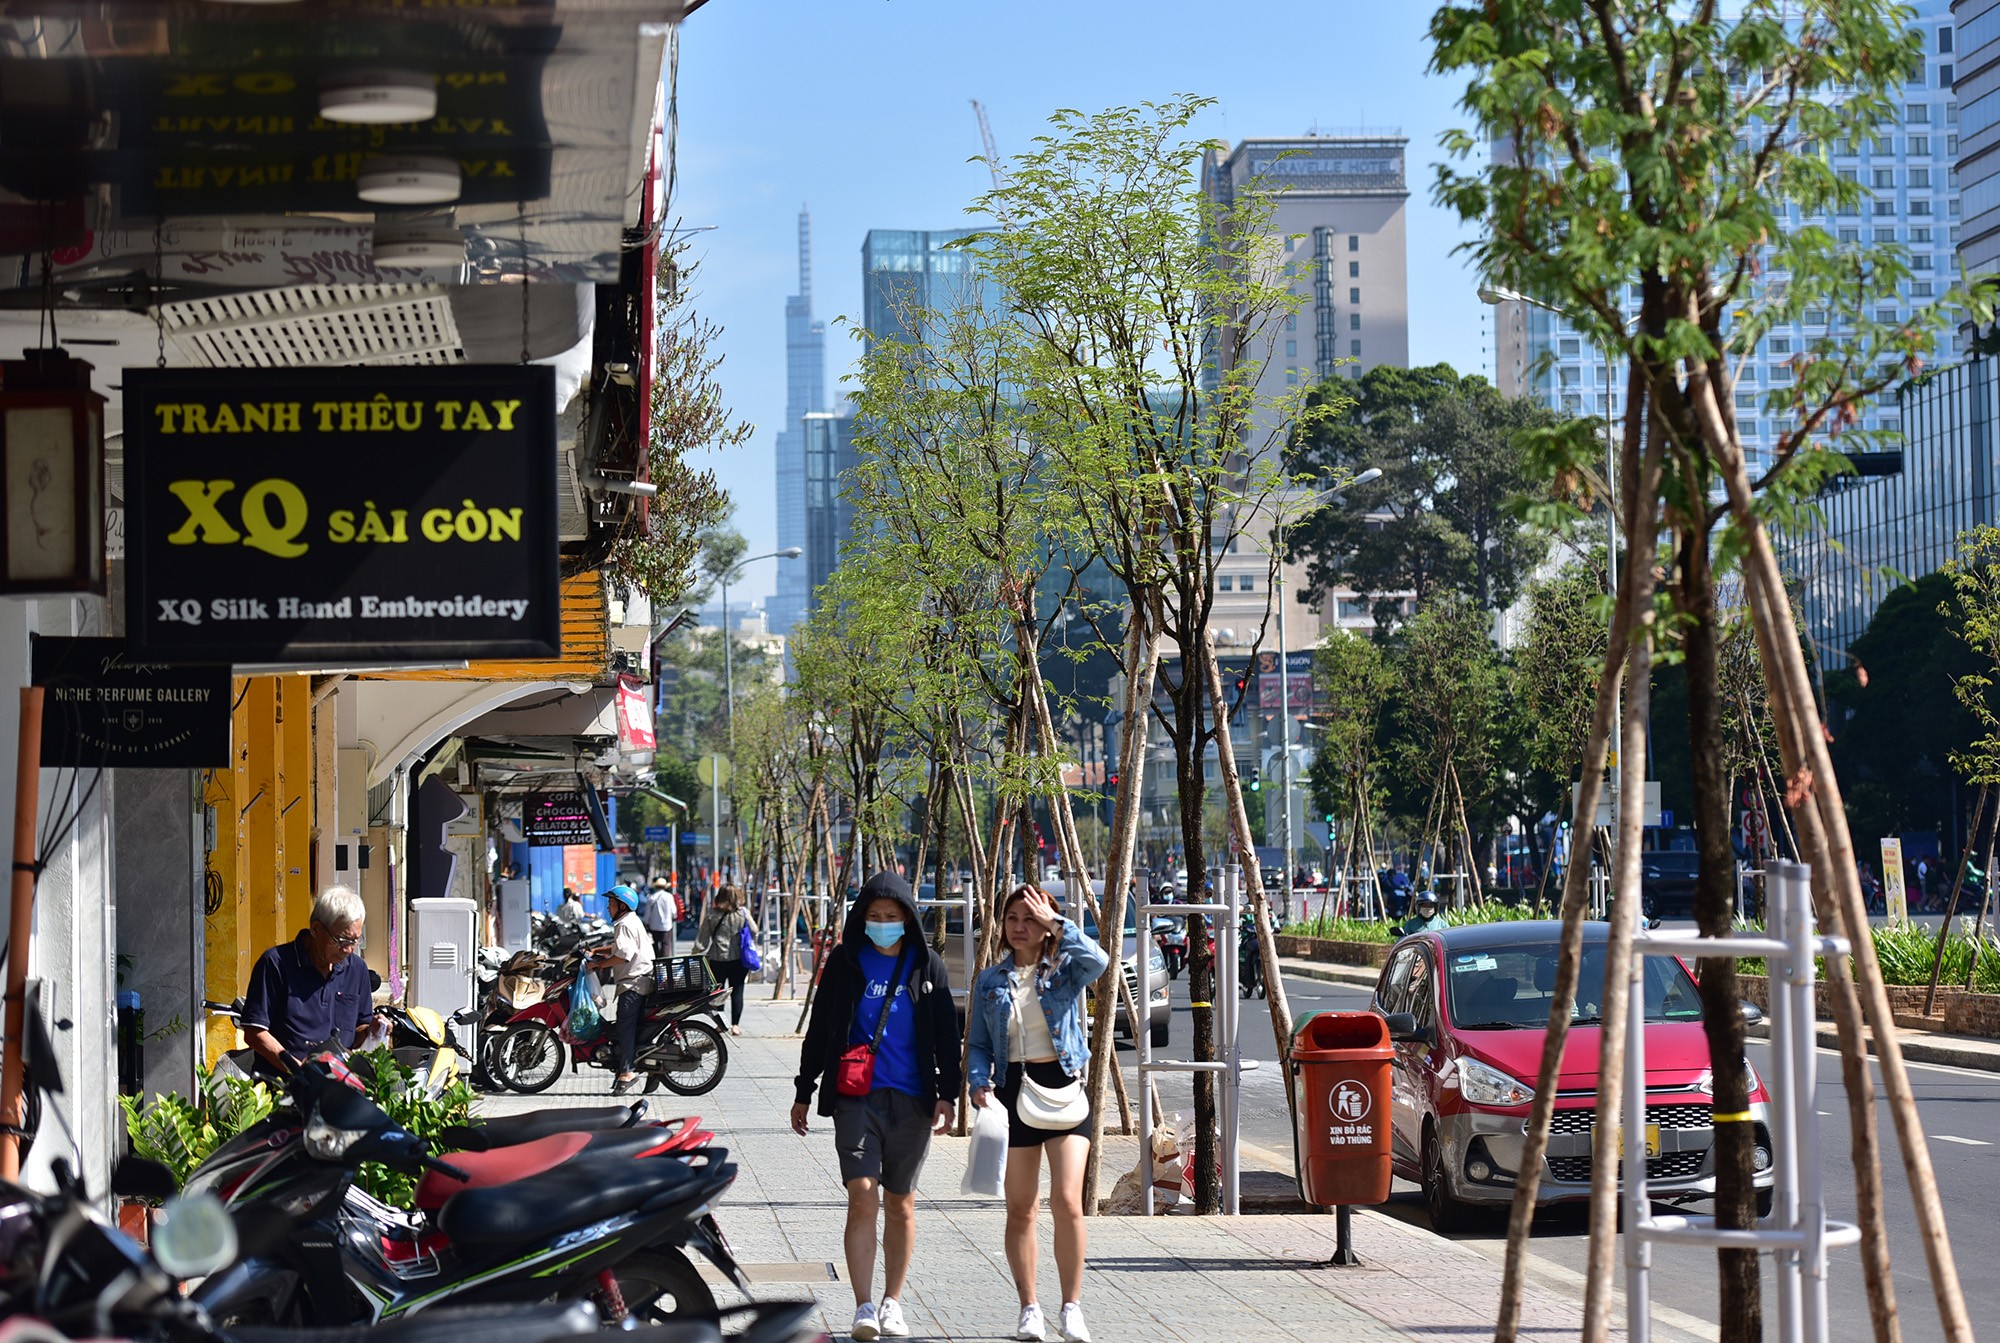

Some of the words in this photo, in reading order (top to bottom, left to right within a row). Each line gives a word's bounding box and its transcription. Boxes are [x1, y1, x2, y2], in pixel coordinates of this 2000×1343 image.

[1350, 160, 1397, 172] HOTEL
[155, 402, 302, 433] TRANH
[312, 393, 423, 432] THÊU
[434, 400, 521, 431] TAY
[167, 478, 310, 559] XQ
[328, 501, 410, 543] SÀI
[421, 499, 523, 542] GÒN
[157, 599, 202, 626] XQ
[210, 598, 270, 621] Silk
[277, 597, 352, 620] Hand
[359, 595, 530, 622] Embroidery
[97, 687, 153, 702] PERFUME
[157, 687, 212, 702] GALLERY
[533, 821, 567, 831] GELATO
[1329, 1126, 1343, 1135] XIN
[1344, 1123, 1356, 1135] BỎ
[1356, 1123, 1373, 1134] RÁC
[1329, 1134, 1346, 1145] VÀO
[1347, 1134, 1373, 1144] THÙNG
